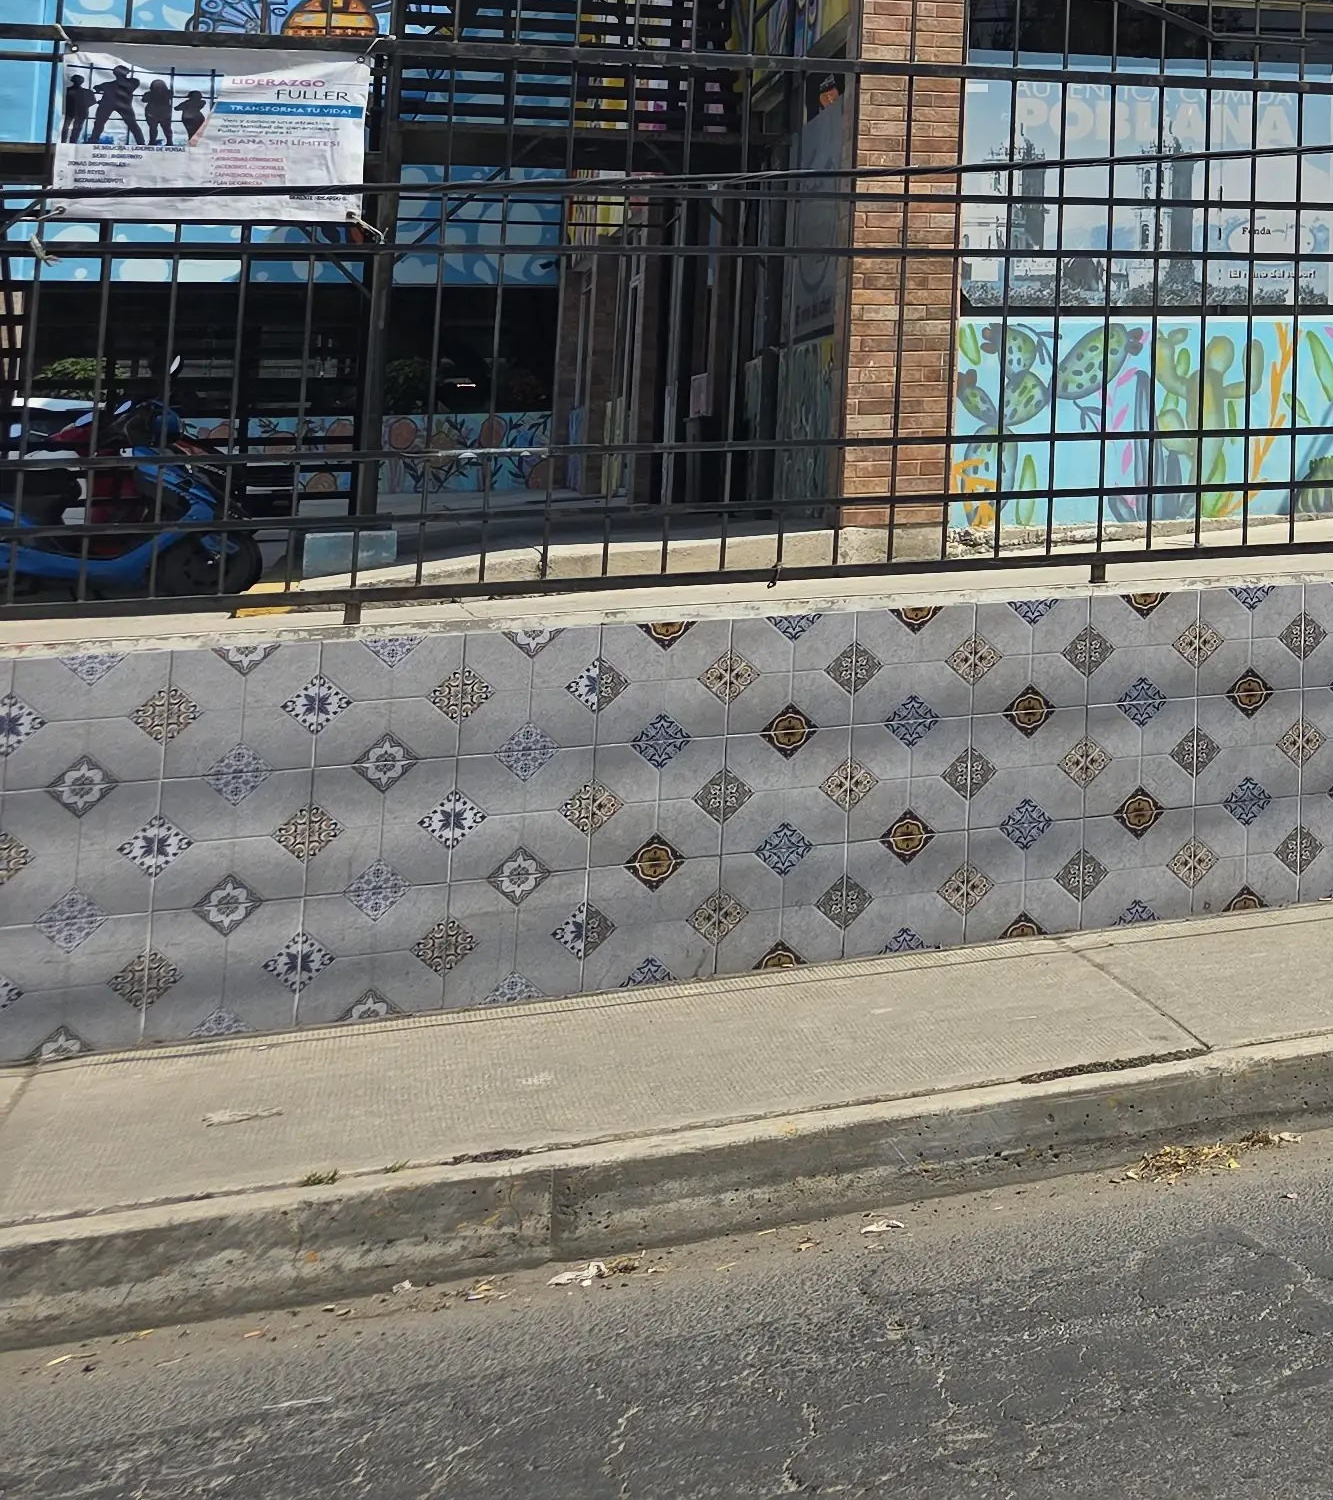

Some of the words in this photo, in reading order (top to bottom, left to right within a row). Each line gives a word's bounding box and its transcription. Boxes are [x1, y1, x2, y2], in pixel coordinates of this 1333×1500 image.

[232, 78, 325, 88] LIDERAZGO
[275, 89, 351, 102] FULLER
[1016, 81, 1168, 102] AUENICA
[1180, 88, 1293, 105] COMDA
[230, 105, 305, 113] TRANSFORMA
[1015, 97, 1297, 146] POBLANA
[222, 138, 263, 146] ¡GANA
